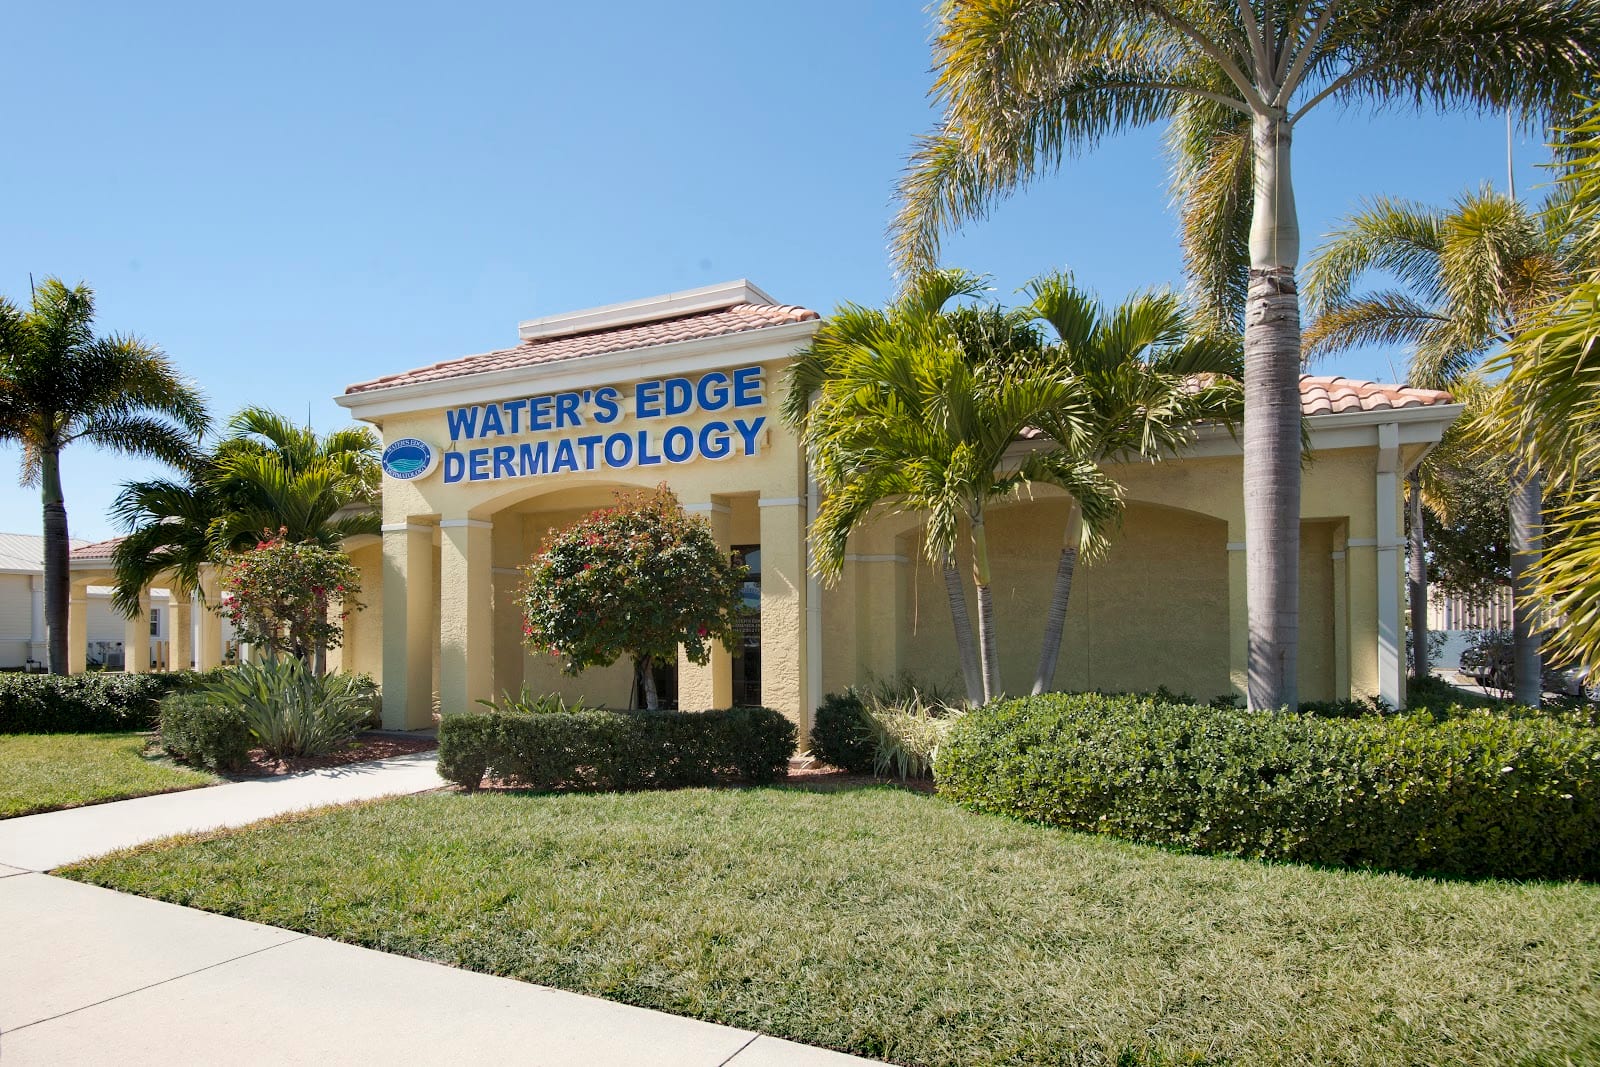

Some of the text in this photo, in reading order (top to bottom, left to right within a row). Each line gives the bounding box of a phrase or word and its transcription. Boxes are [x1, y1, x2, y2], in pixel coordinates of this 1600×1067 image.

[447, 367, 763, 441] WATER'S EDGE
[444, 417, 766, 483] DERMATOLOGY
